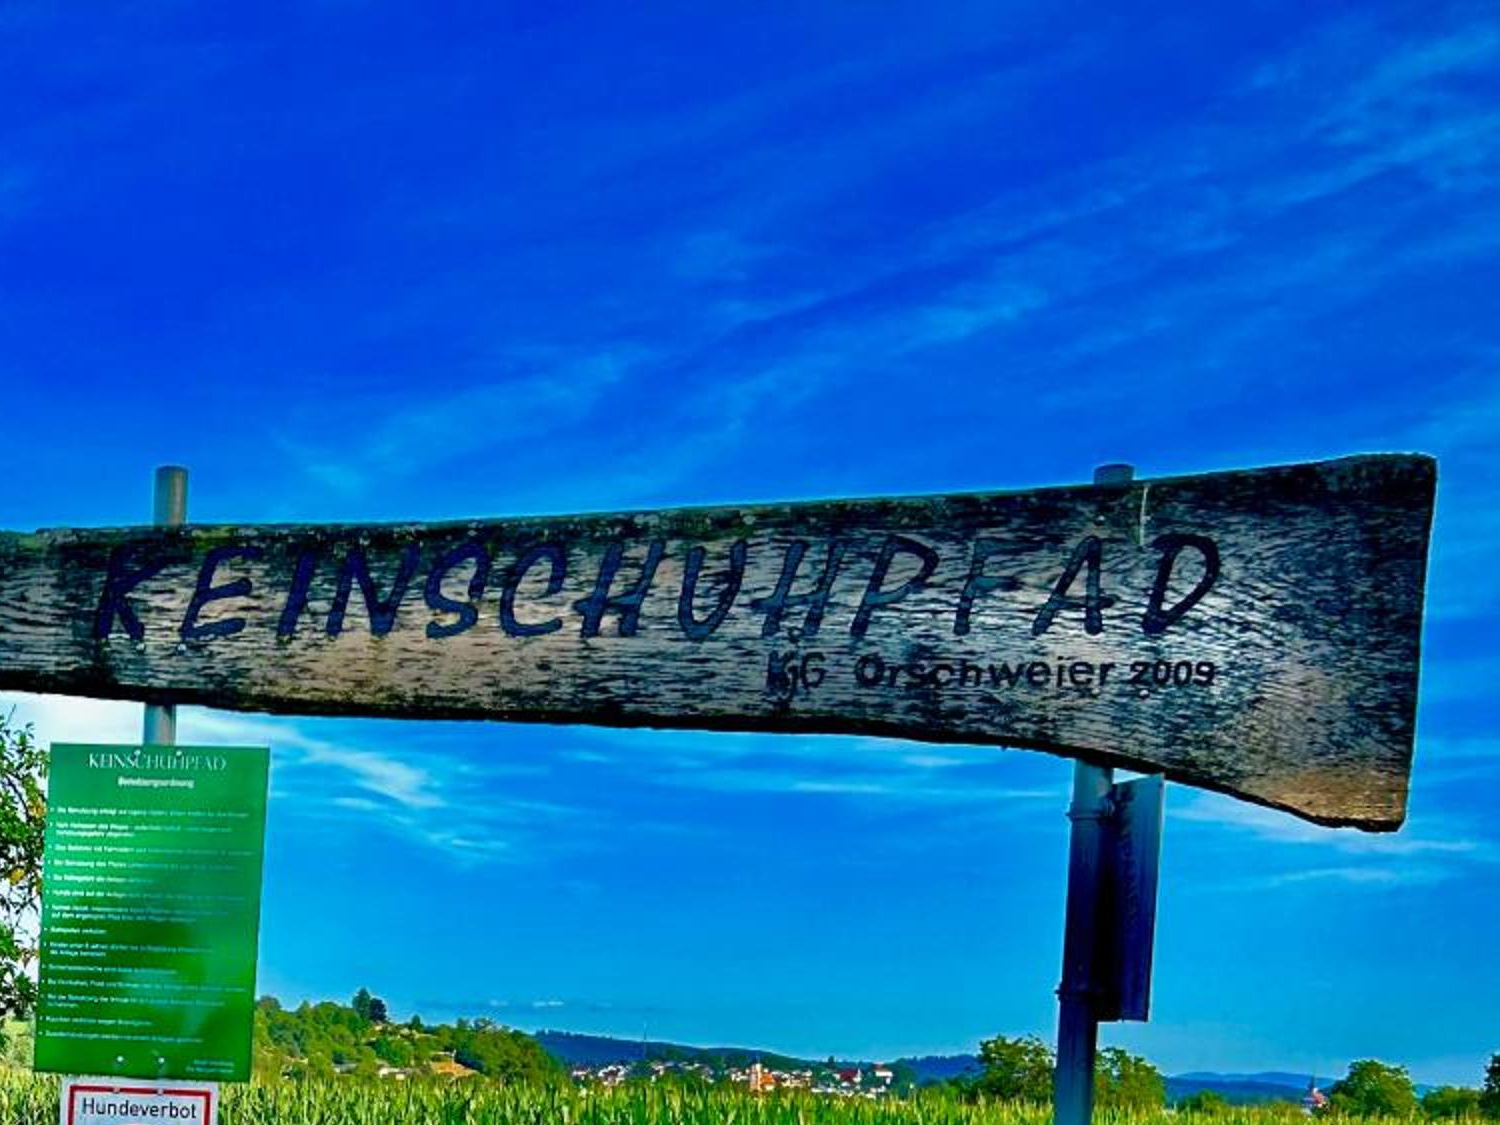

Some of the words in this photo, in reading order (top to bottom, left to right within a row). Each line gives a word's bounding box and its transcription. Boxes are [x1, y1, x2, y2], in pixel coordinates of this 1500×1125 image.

[100, 533, 1222, 641] KEINSCHUHPFAD
[854, 651, 1115, 688] Orschweier
[1130, 658, 1217, 689] 2009
[88, 752, 227, 771] KEINSCHUHPFAD
[82, 1097, 197, 1119] Hundeverbot
